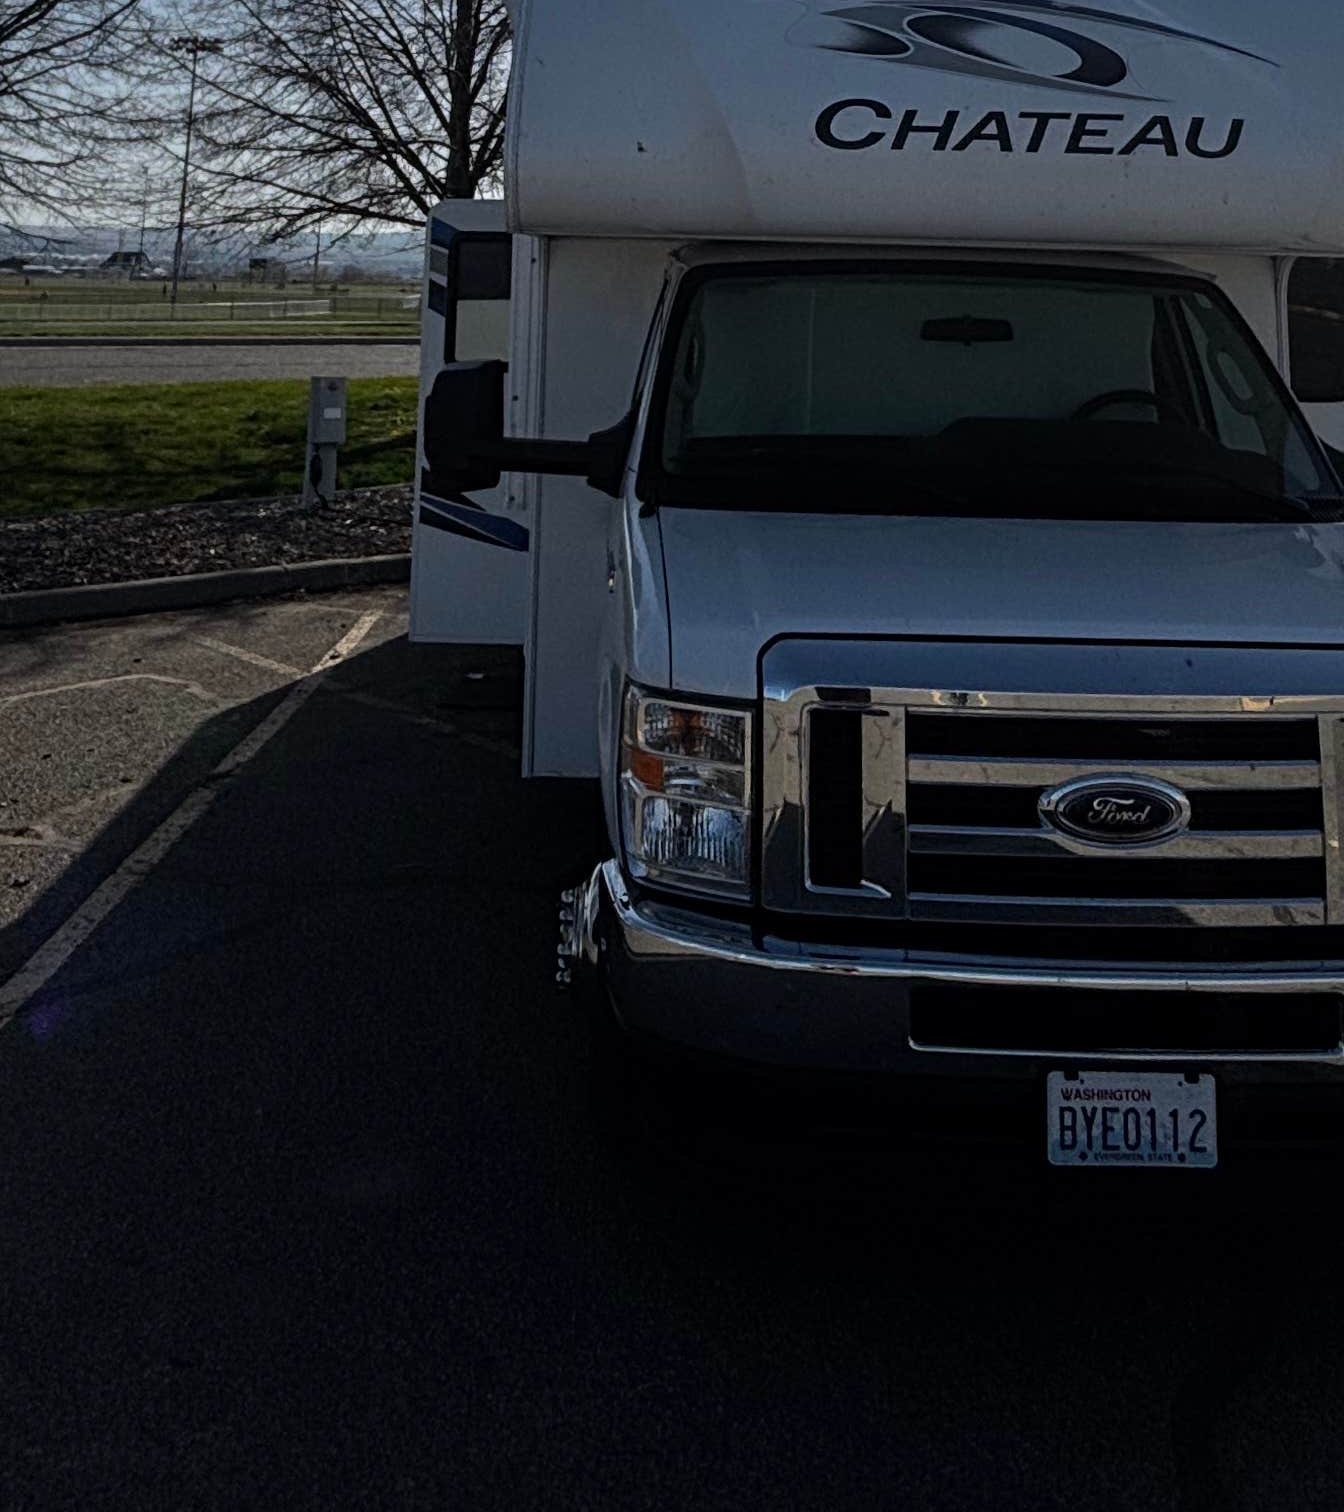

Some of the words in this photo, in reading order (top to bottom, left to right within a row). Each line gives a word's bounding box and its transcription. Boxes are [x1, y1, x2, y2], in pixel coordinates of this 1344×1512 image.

[813, 97, 1244, 159] CHATEAU
[1087, 796, 1152, 824] Ford
[1060, 1088, 1152, 1101] WASHINGTON
[1058, 1106, 1208, 1153] BYE0112
[1147, 1153, 1173, 1162] STATE
